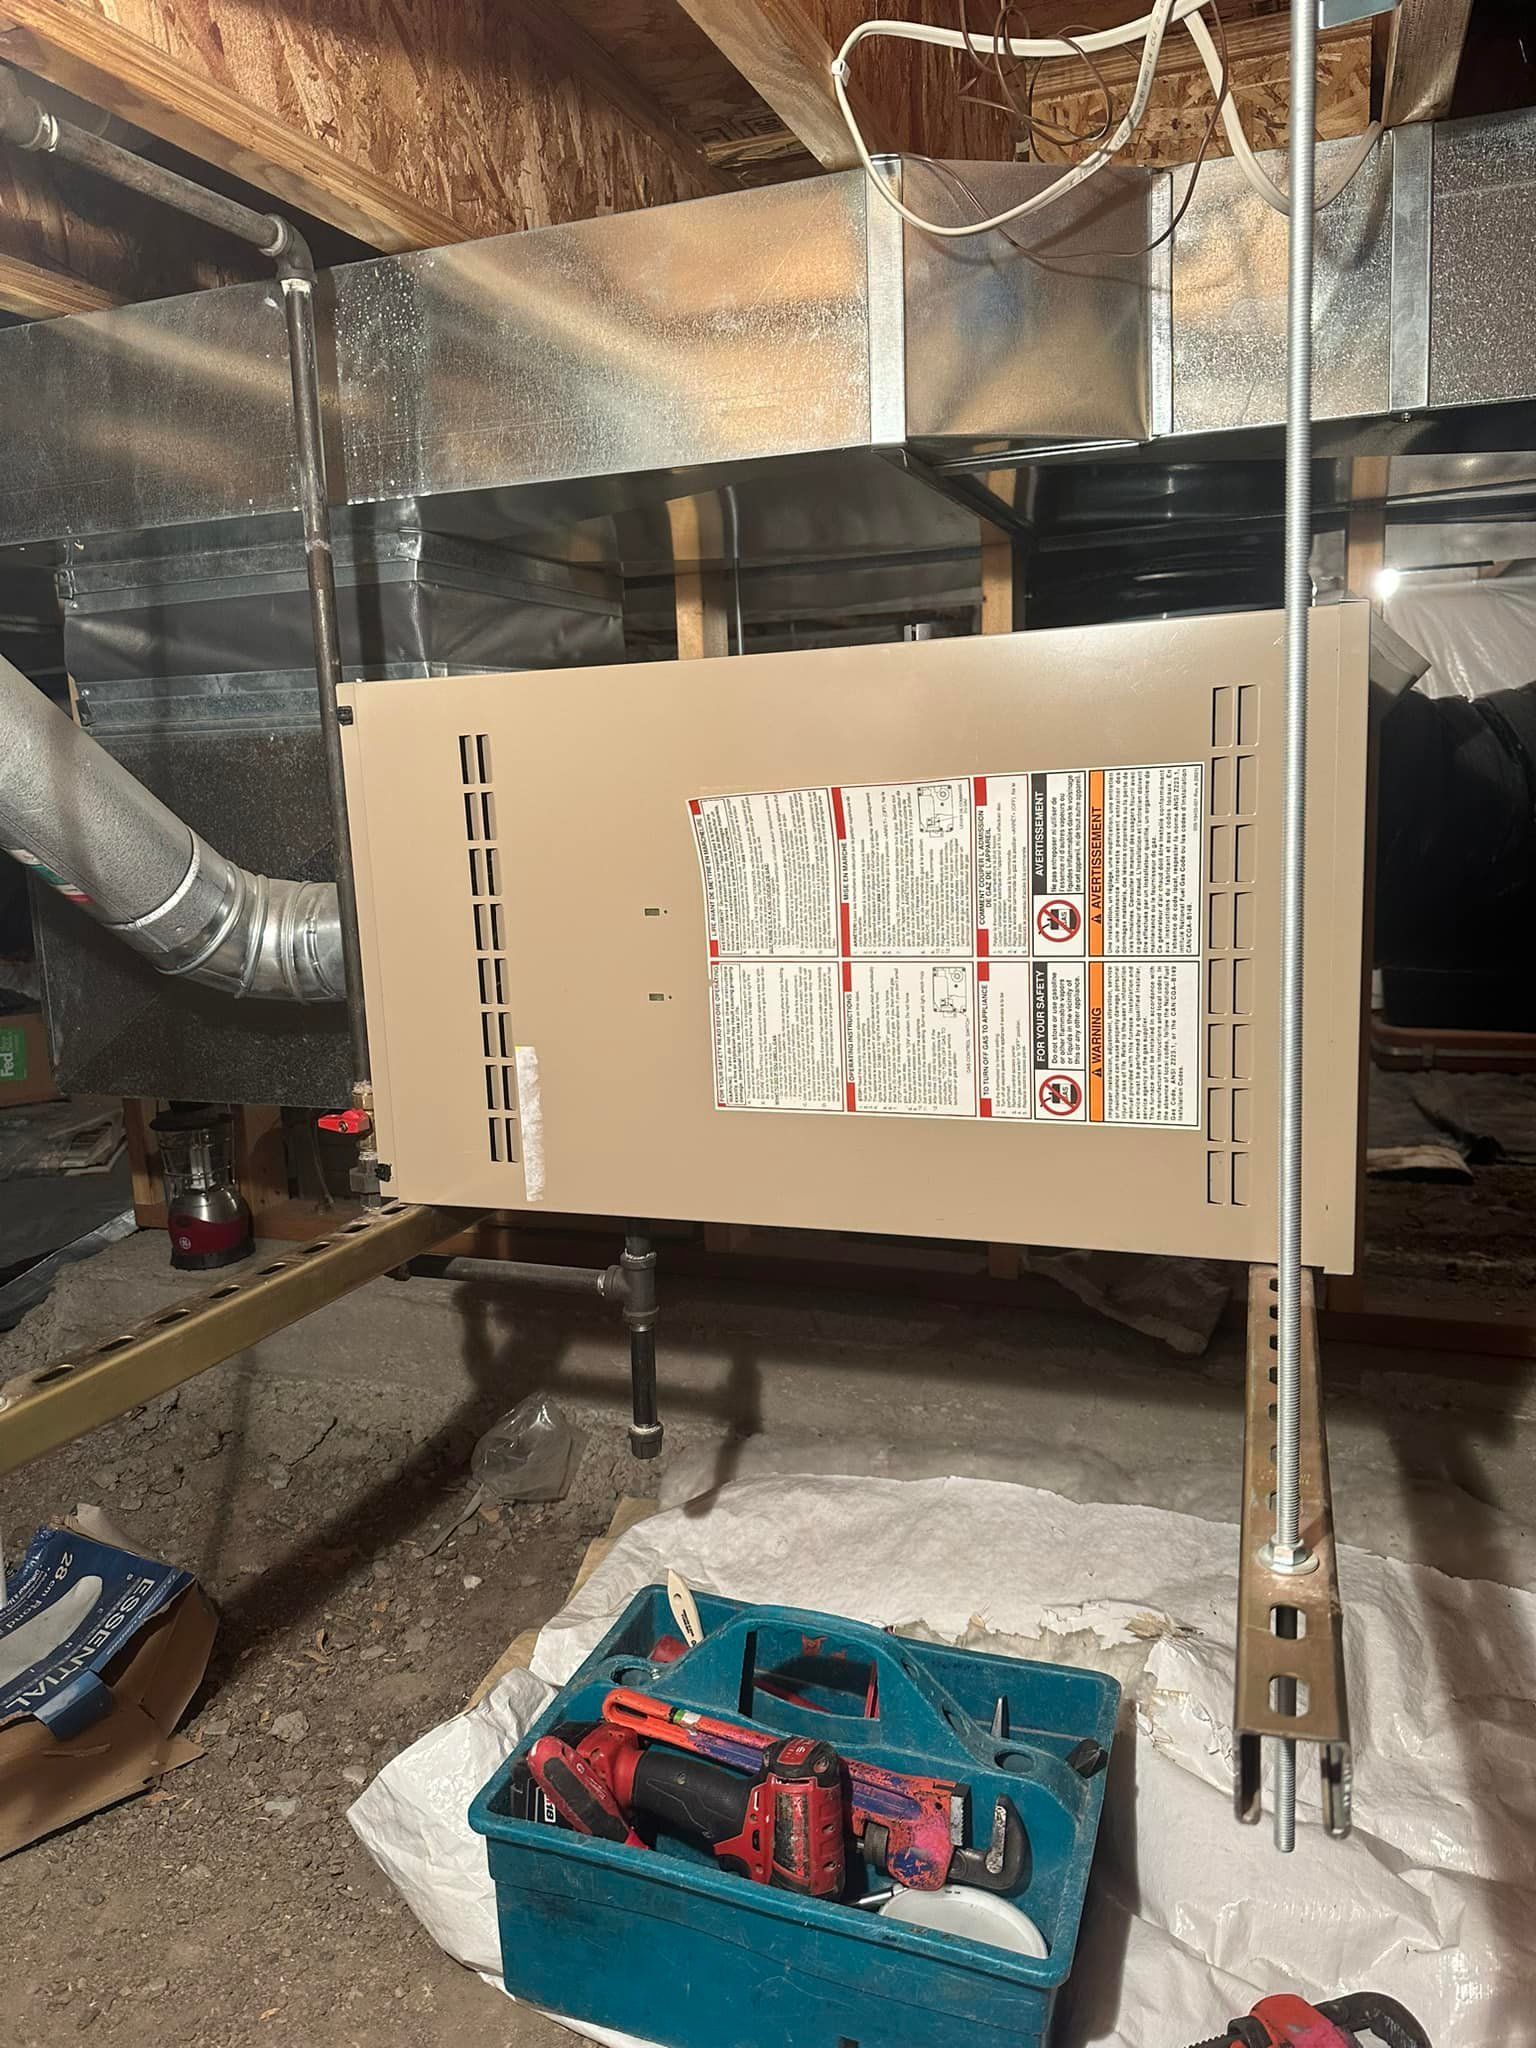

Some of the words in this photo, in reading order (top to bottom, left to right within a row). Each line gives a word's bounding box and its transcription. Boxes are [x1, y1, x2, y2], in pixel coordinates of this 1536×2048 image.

[1035, 792, 1044, 876] AVERTISSEMENT
[704, 856, 711, 864] EN
[1092, 807, 1101, 909] AVERTISSEMENT
[705, 865, 714, 890] METTRE
[842, 873, 848, 882] EN
[986, 870, 991, 880] DE
[708, 891, 715, 900] DE
[986, 898, 992, 908] DE
[1036, 971, 1045, 1009] SAFETY
[982, 1024, 988, 1034] TO
[1036, 1011, 1045, 1039] YOUR
[1092, 1008, 1101, 1063] WARNING
[1037, 1041, 1045, 1062] FOR
[983, 1086, 989, 1095] TO
[54, 1551, 73, 1583] 28
[41, 1580, 57, 1599] cm
[5, 1577, 156, 1711] ESSENTIAL
